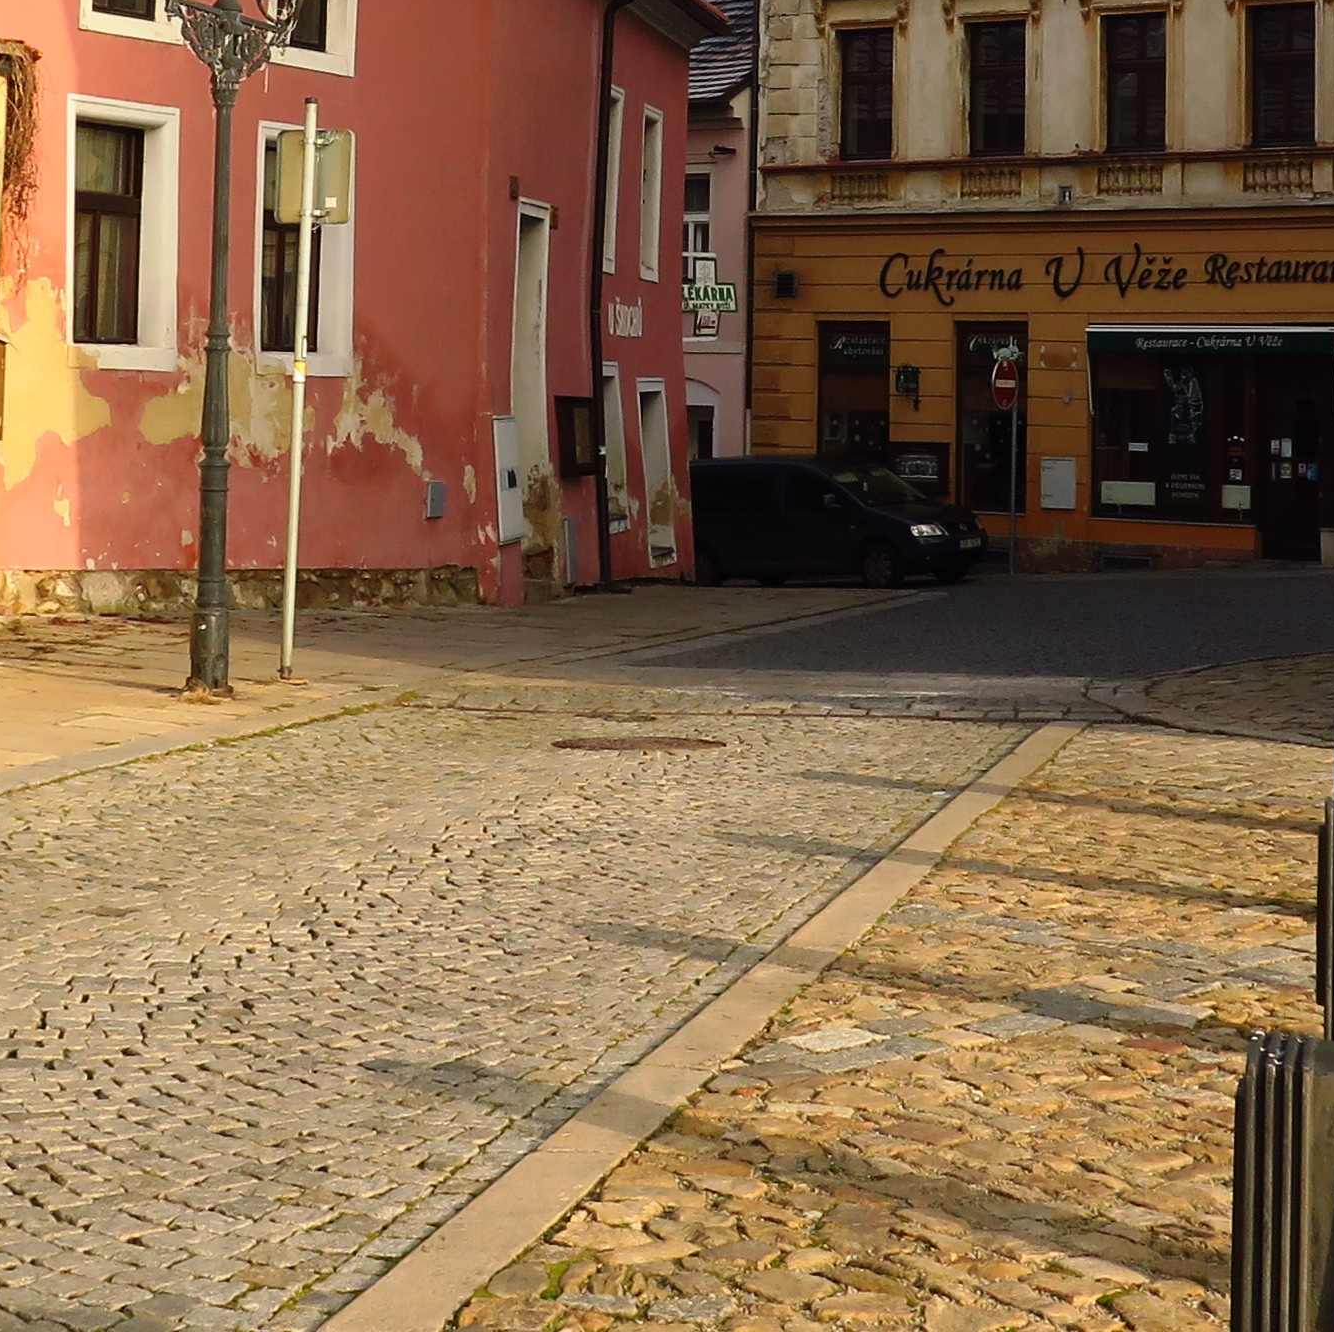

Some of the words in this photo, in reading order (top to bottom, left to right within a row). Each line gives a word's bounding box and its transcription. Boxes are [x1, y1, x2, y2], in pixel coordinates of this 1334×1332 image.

[879, 248, 1023, 305] Cukrárna
[1045, 247, 1085, 298] U
[1104, 243, 1188, 298] Věže
[1135, 337, 1188, 351] Restaurace
[1196, 334, 1242, 350] Cukrárna
[1245, 334, 1256, 347] U
[1258, 334, 1283, 347] Věže
